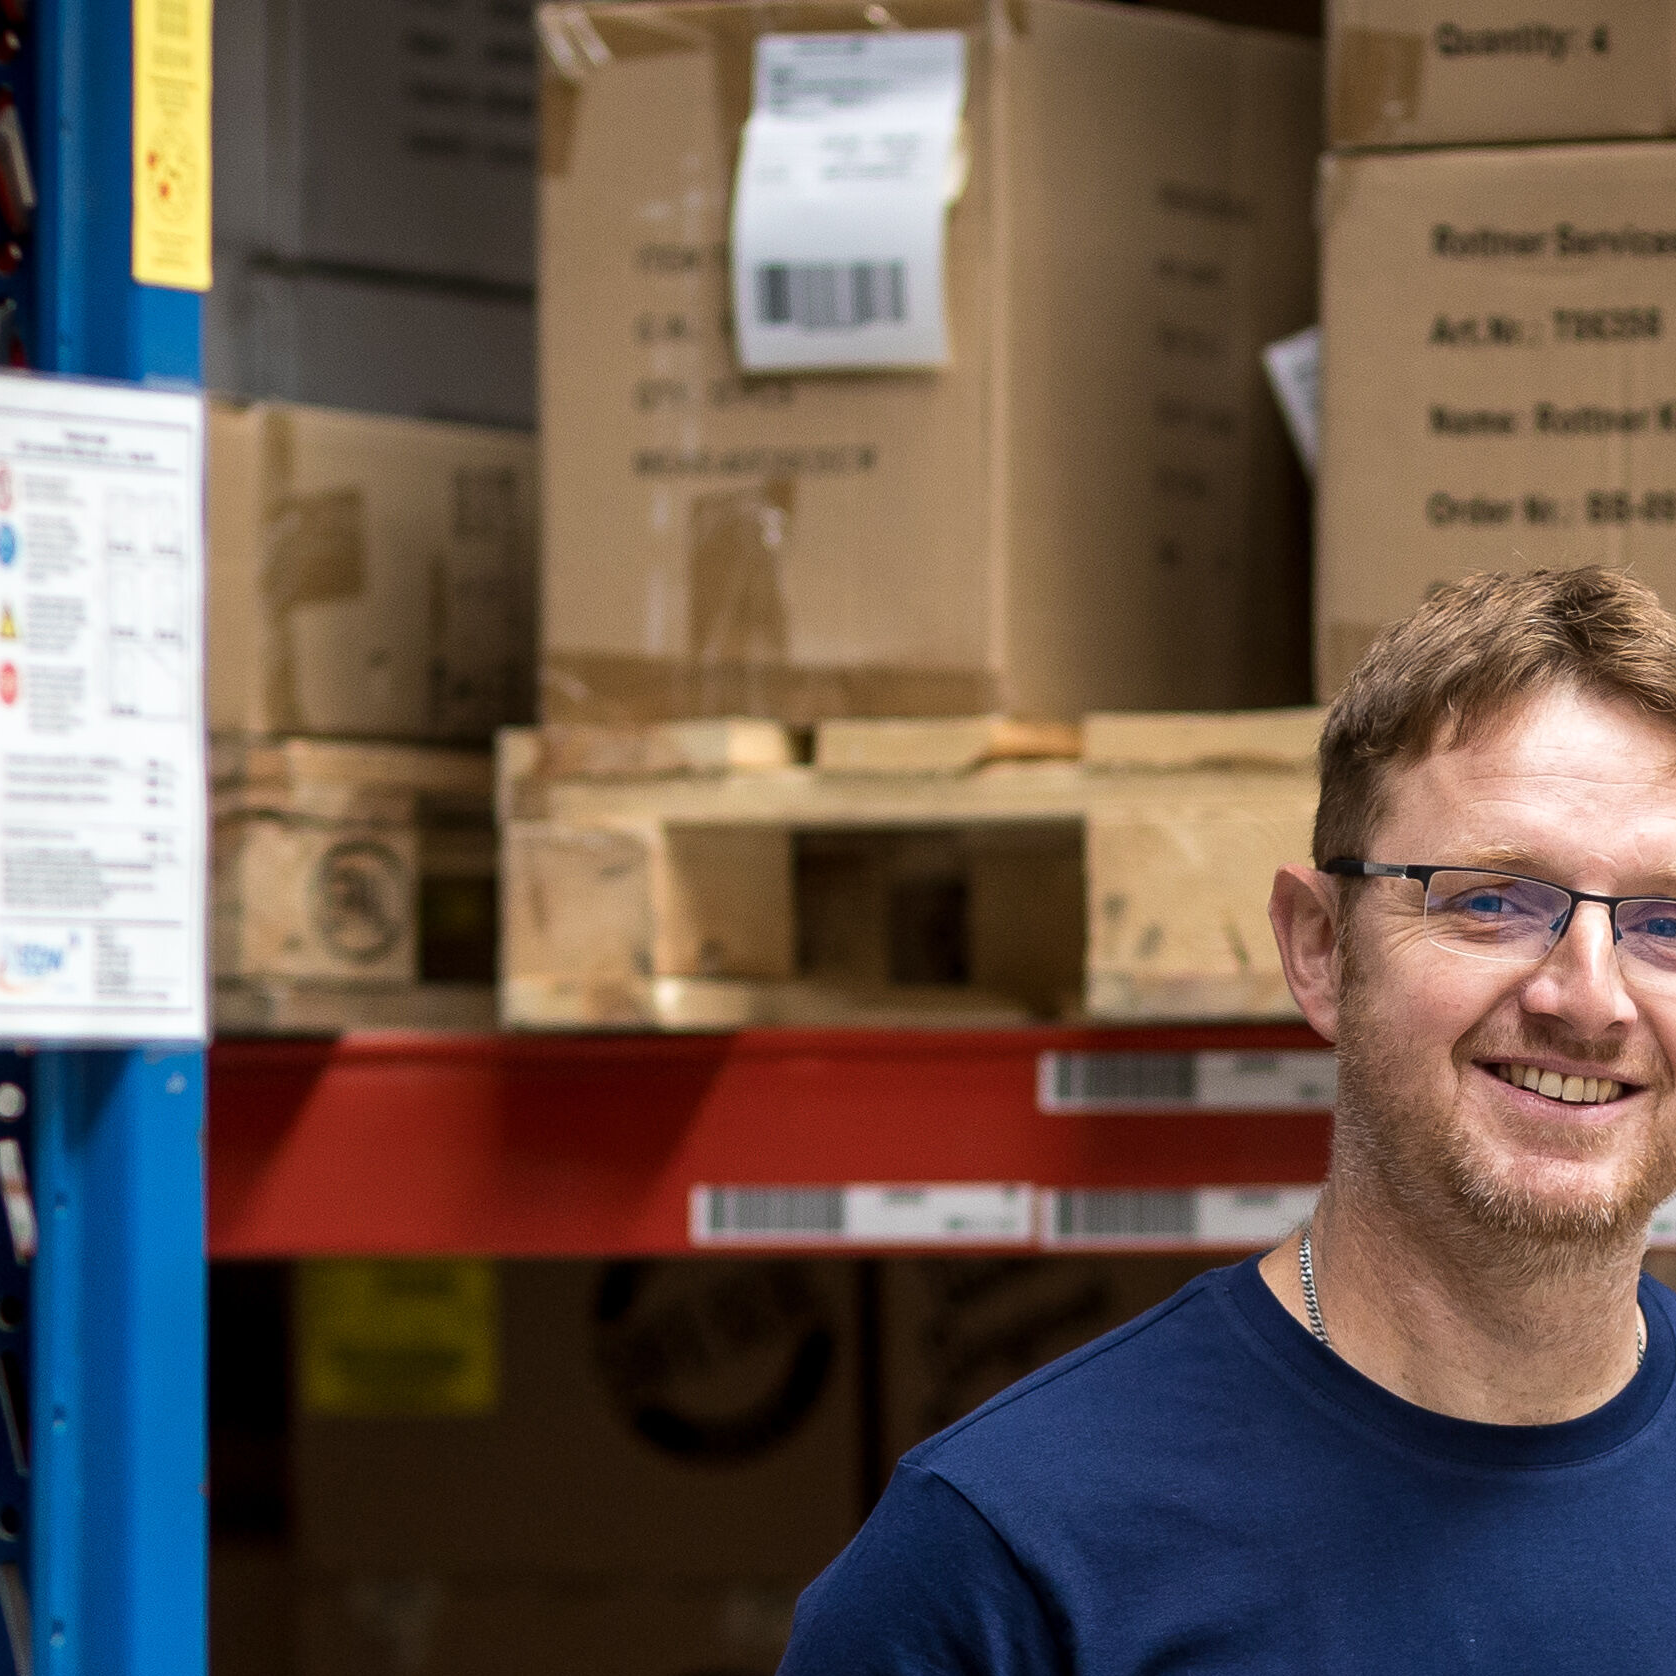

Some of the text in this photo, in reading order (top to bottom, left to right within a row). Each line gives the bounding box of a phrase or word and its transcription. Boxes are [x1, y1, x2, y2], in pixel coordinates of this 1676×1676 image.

[1429, 222, 1549, 261] Rottner
[1531, 399, 1655, 439] Rottner
[1424, 490, 1516, 530] Order
